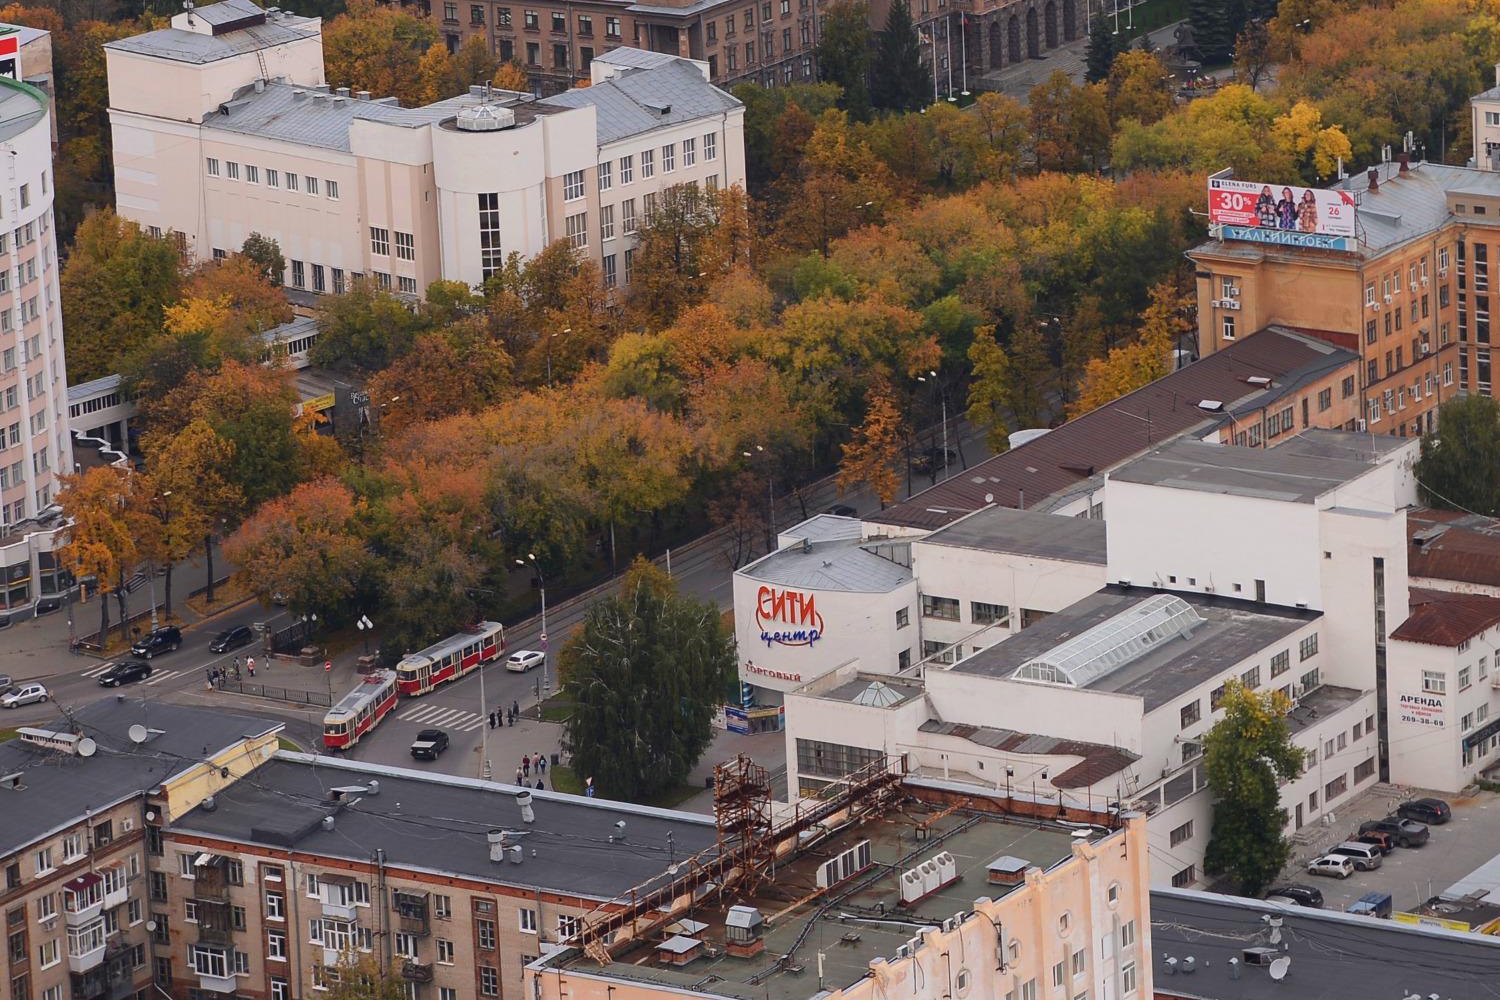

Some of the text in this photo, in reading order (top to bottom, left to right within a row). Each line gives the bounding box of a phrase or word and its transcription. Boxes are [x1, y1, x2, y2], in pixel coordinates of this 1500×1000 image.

[1328, 207, 1340, 216] 26
[758, 585, 816, 626] СИТИ
[760, 630, 821, 648] центр
[744, 663, 802, 683] ТОРГОВЫЙ
[1400, 695, 1443, 708] АРЕНДА
